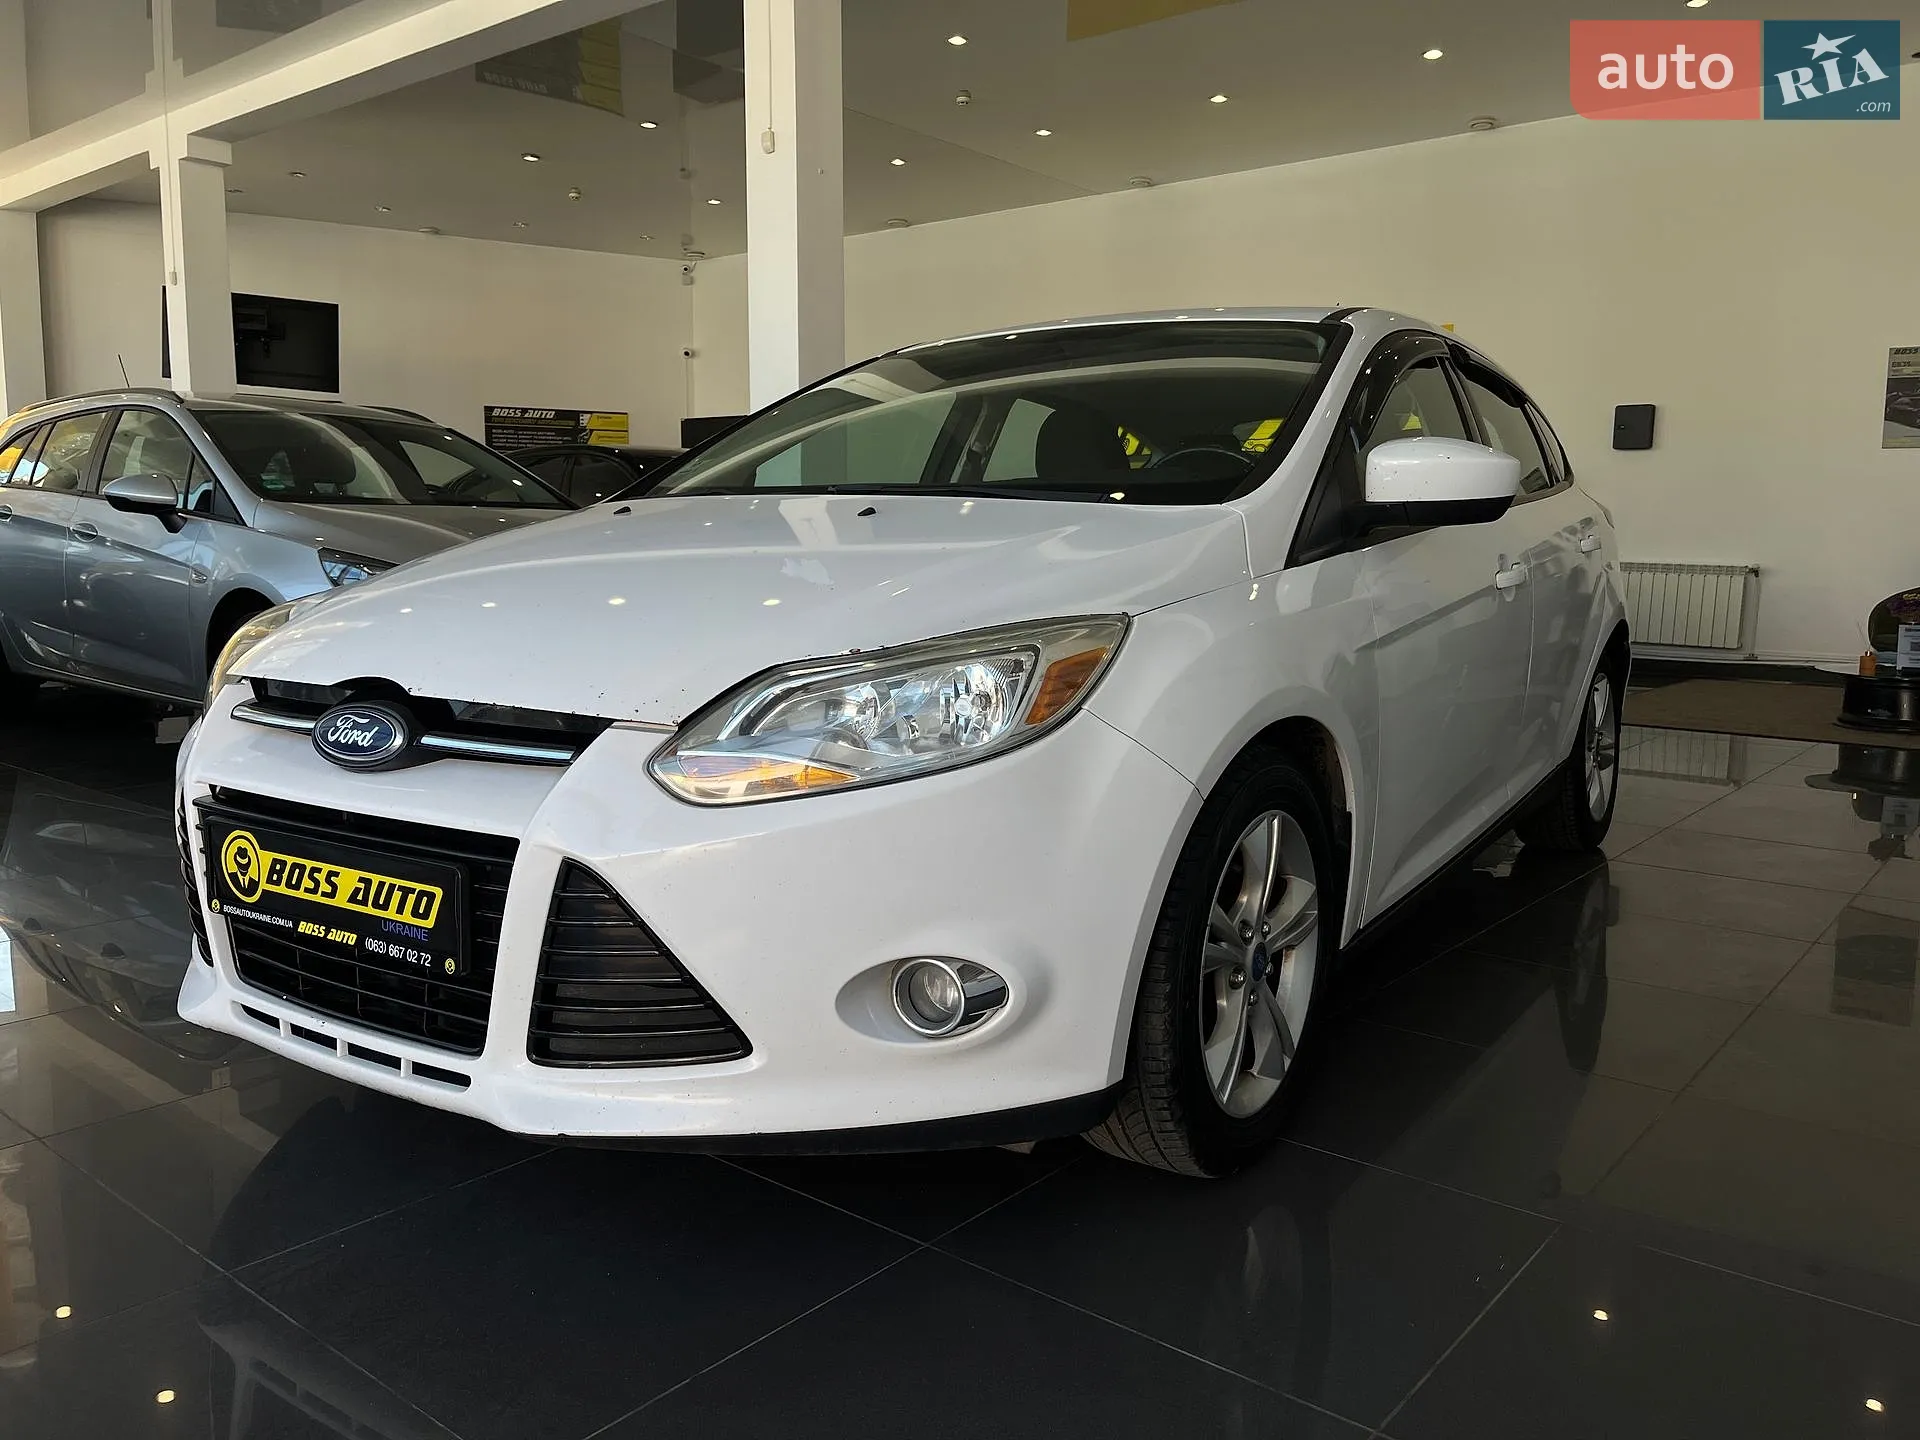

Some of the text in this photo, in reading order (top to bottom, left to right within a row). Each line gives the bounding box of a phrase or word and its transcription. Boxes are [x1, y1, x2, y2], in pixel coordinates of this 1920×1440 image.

[492, 408, 556, 419] BOSS AUTO
[327, 714, 380, 748] Ford
[265, 857, 437, 921] BOSS AUTO
[223, 904, 294, 929] BOSSAUTOUKRAINE.COM.UA
[297, 920, 358, 946] BOSS AUTO
[381, 919, 429, 942] UKRAINE
[365, 937, 432, 967] (063) 667 02 72
